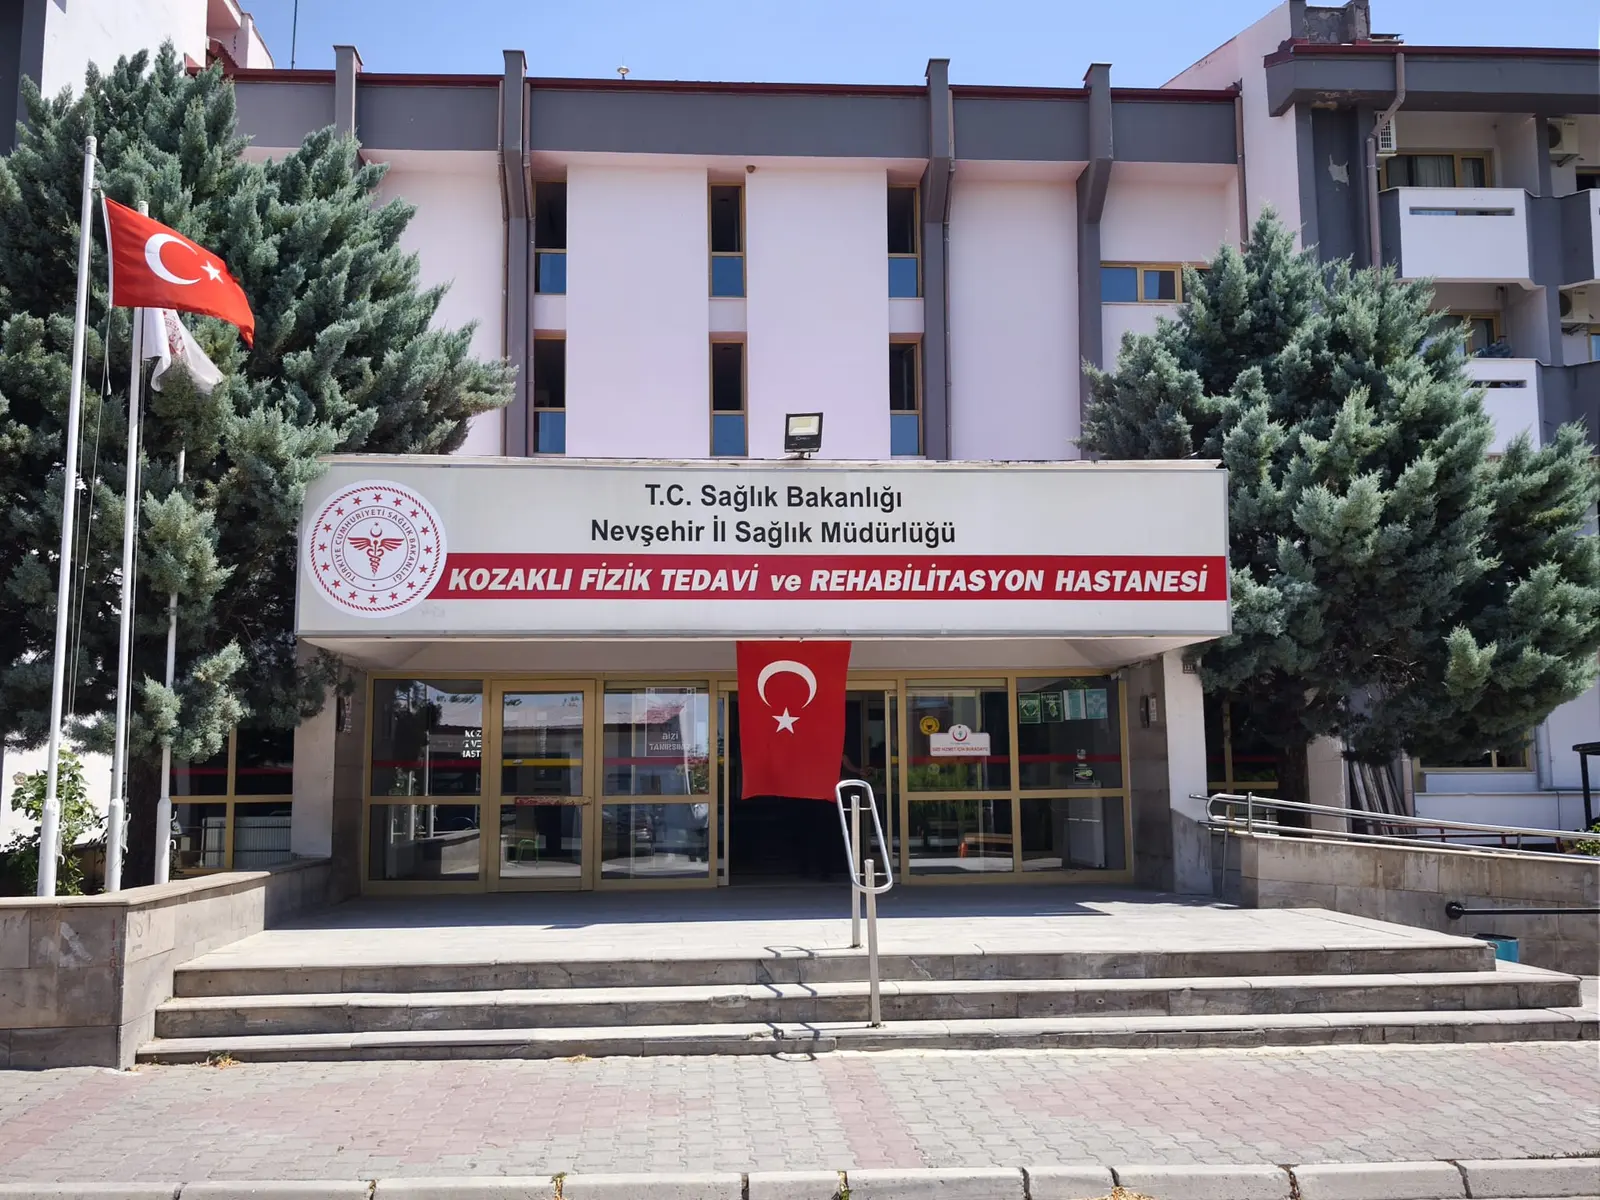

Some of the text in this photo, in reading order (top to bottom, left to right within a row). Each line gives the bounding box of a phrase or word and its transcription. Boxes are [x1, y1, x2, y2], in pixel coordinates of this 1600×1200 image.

[644, 484, 902, 514] T.C. Sağlık Bakanlığı
[335, 508, 385, 546] CUMHURİYETİ
[387, 510, 414, 537] SAĞLIK
[591, 515, 956, 549] Nevşehir İl Sağlık Müdürlüğü
[448, 561, 1208, 593] KOZAKLI FİZİK TEDAVİ ve REHABİLİTASYON HASTANESİ
